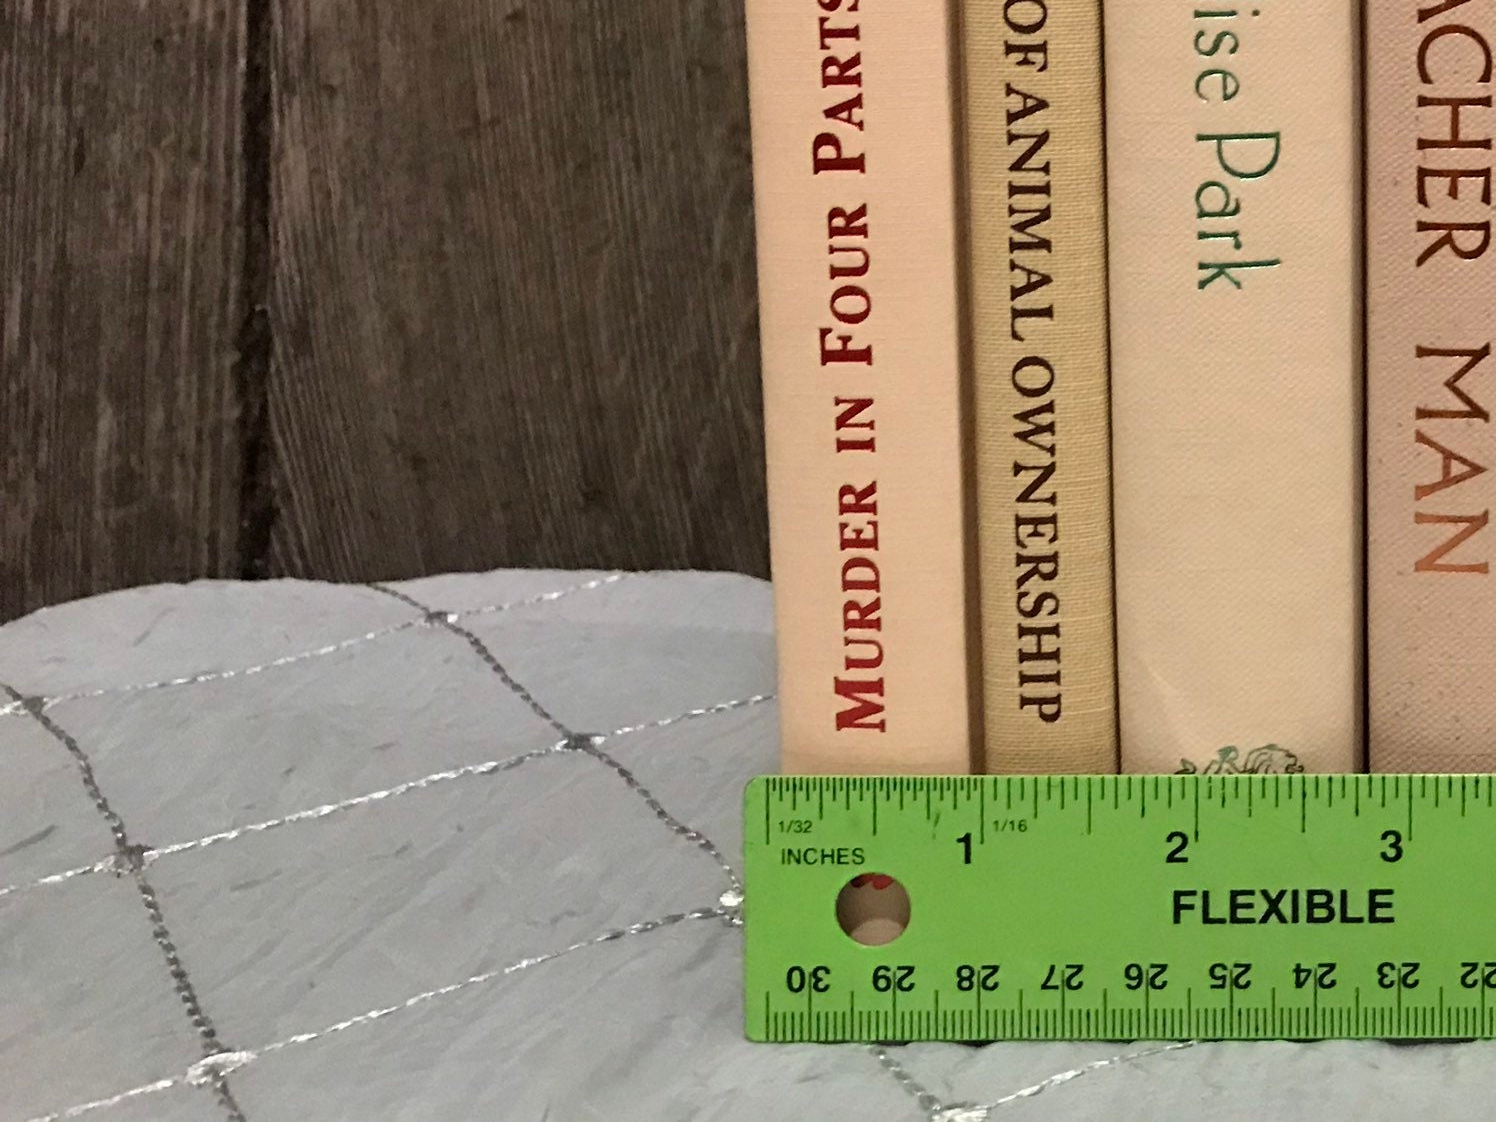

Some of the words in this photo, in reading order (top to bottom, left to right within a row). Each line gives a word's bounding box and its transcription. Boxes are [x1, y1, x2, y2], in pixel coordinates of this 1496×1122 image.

[1005, 85, 1054, 342] ANIMAL
[1195, 130, 1282, 292] Park
[821, 202, 873, 366] FOUR
[836, 396, 876, 454] IN
[1413, 342, 1491, 576] MAN
[1010, 355, 1063, 724] OWNERSHIP
[835, 480, 885, 733] MURDER
[778, 819, 813, 835] 1/32
[993, 819, 1029, 834] 1/16
[780, 847, 866, 866] INCHES
[956, 832, 974, 865] 1
[1165, 831, 1190, 865] 2
[1379, 829, 1403, 864] 3
[1172, 889, 1396, 926] FLEXIBLE
[786, 964, 830, 994] 30
[872, 964, 915, 993] 29
[956, 963, 999, 992] 28
[1040, 963, 1084, 991] 27
[1123, 963, 1168, 991] 26
[1208, 962, 1252, 990] 25
[1292, 962, 1337, 990] 24
[1377, 961, 1420, 989] 23
